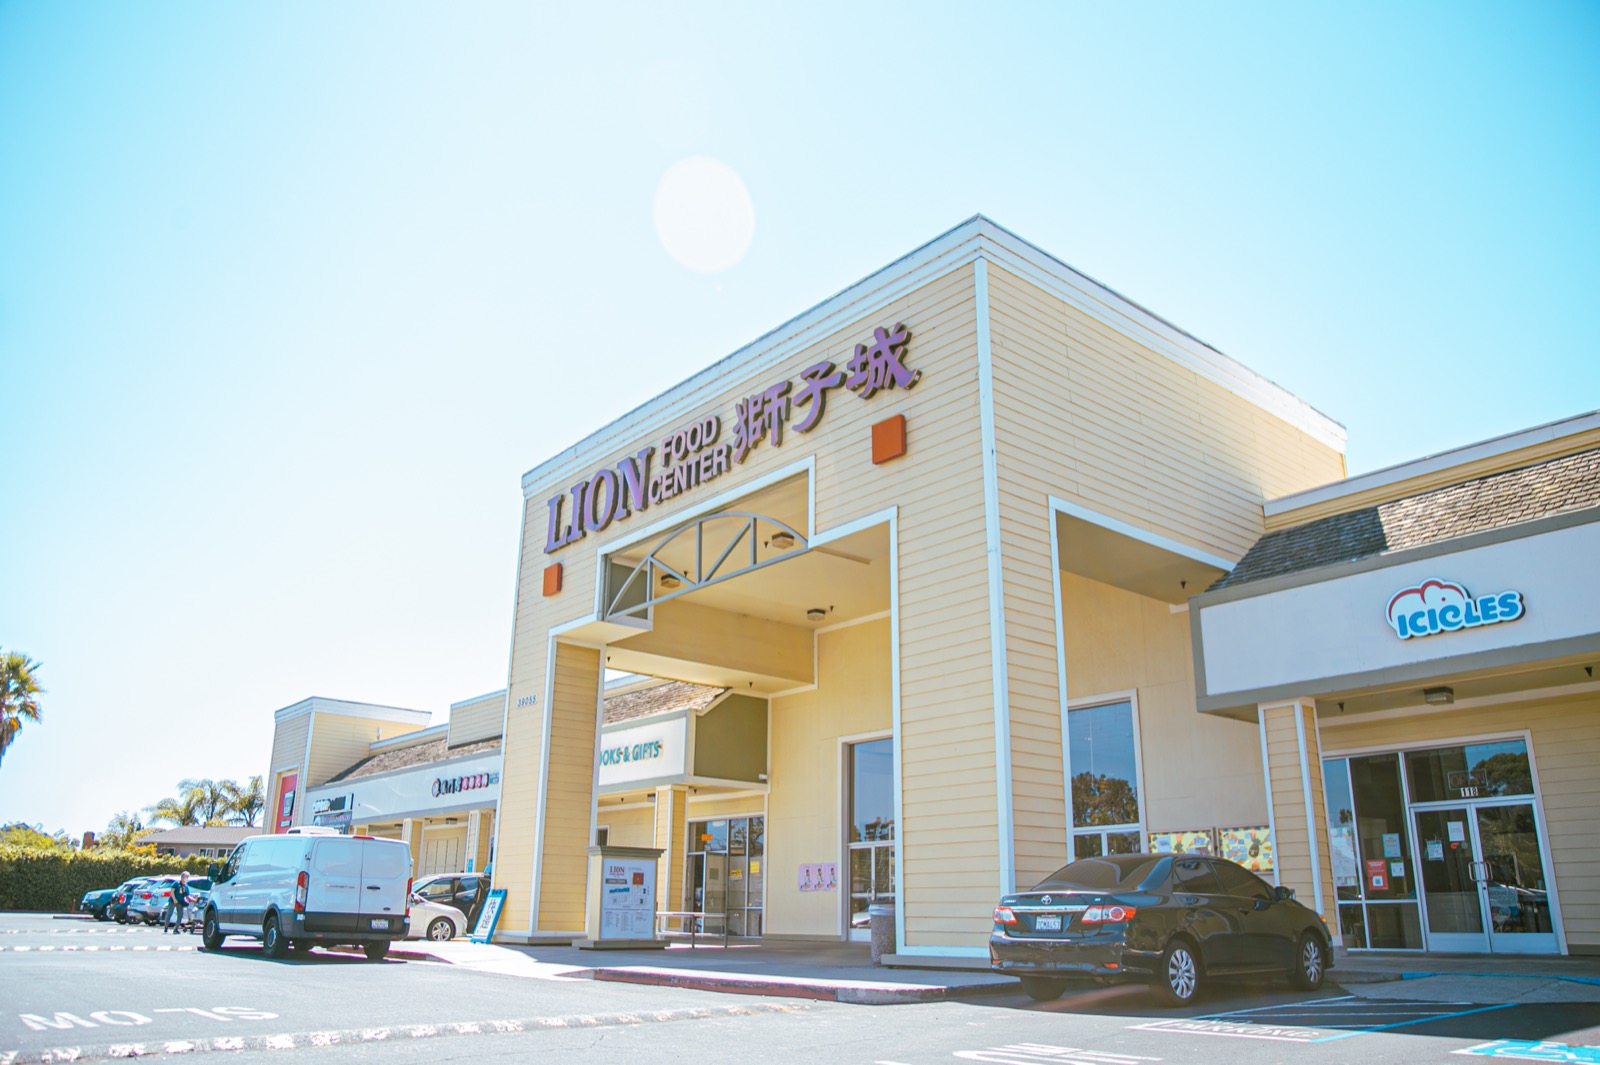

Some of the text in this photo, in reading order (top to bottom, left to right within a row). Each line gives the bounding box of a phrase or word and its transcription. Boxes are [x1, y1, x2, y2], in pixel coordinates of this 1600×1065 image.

[732, 322, 922, 464] 獅子城
[660, 415, 721, 467] FOOD
[649, 444, 732, 504] CENTER
[544, 447, 656, 554] LION
[1397, 593, 1519, 637] ICICLES
[632, 740, 660, 761] GIFTS
[1451, 771, 1486, 787] OPN
[1461, 787, 1478, 797] 118
[19, 1006, 279, 1030] SLOW
